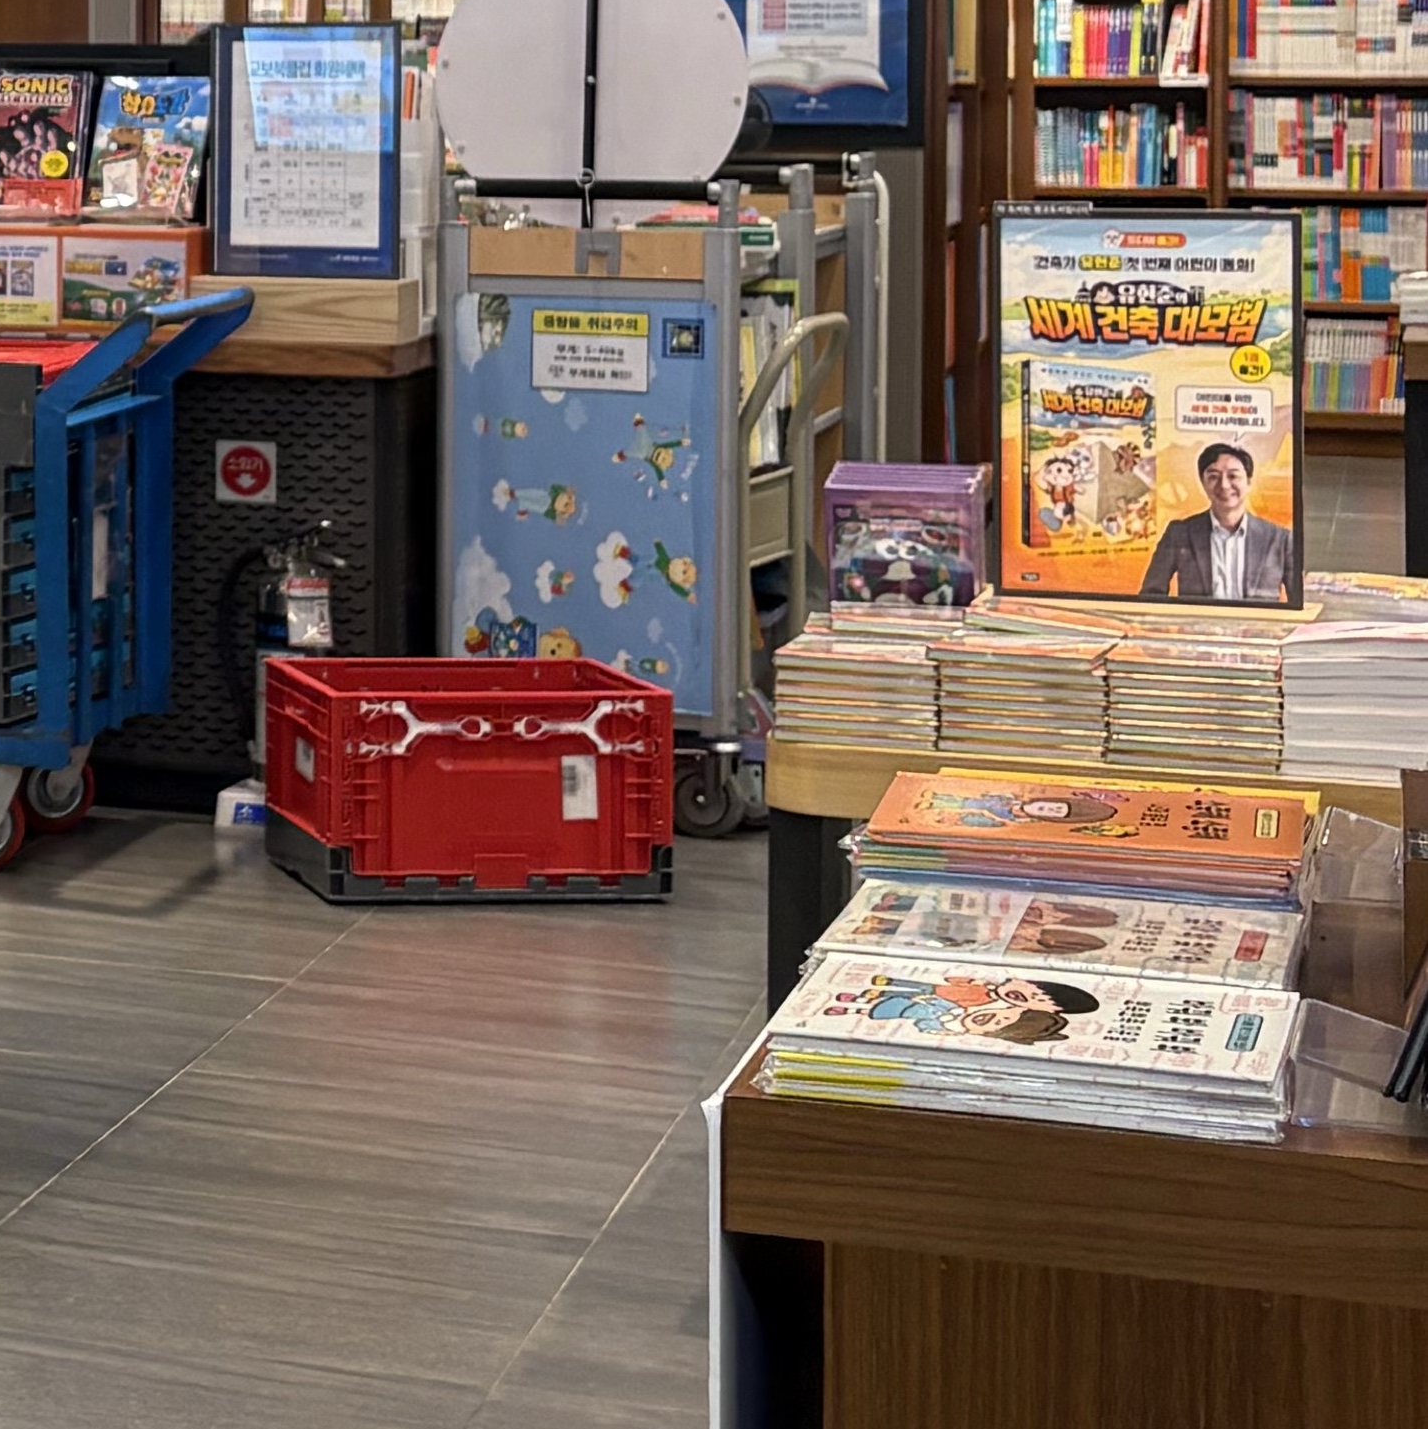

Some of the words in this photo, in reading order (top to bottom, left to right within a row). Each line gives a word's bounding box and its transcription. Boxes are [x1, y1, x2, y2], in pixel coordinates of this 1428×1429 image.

[1033, 255, 1076, 271] 건축가
[1175, 256, 1218, 273] 어린이
[1025, 296, 1098, 342] 세계
[1097, 304, 1159, 344] 건축
[1162, 298, 1267, 346] 대모험
